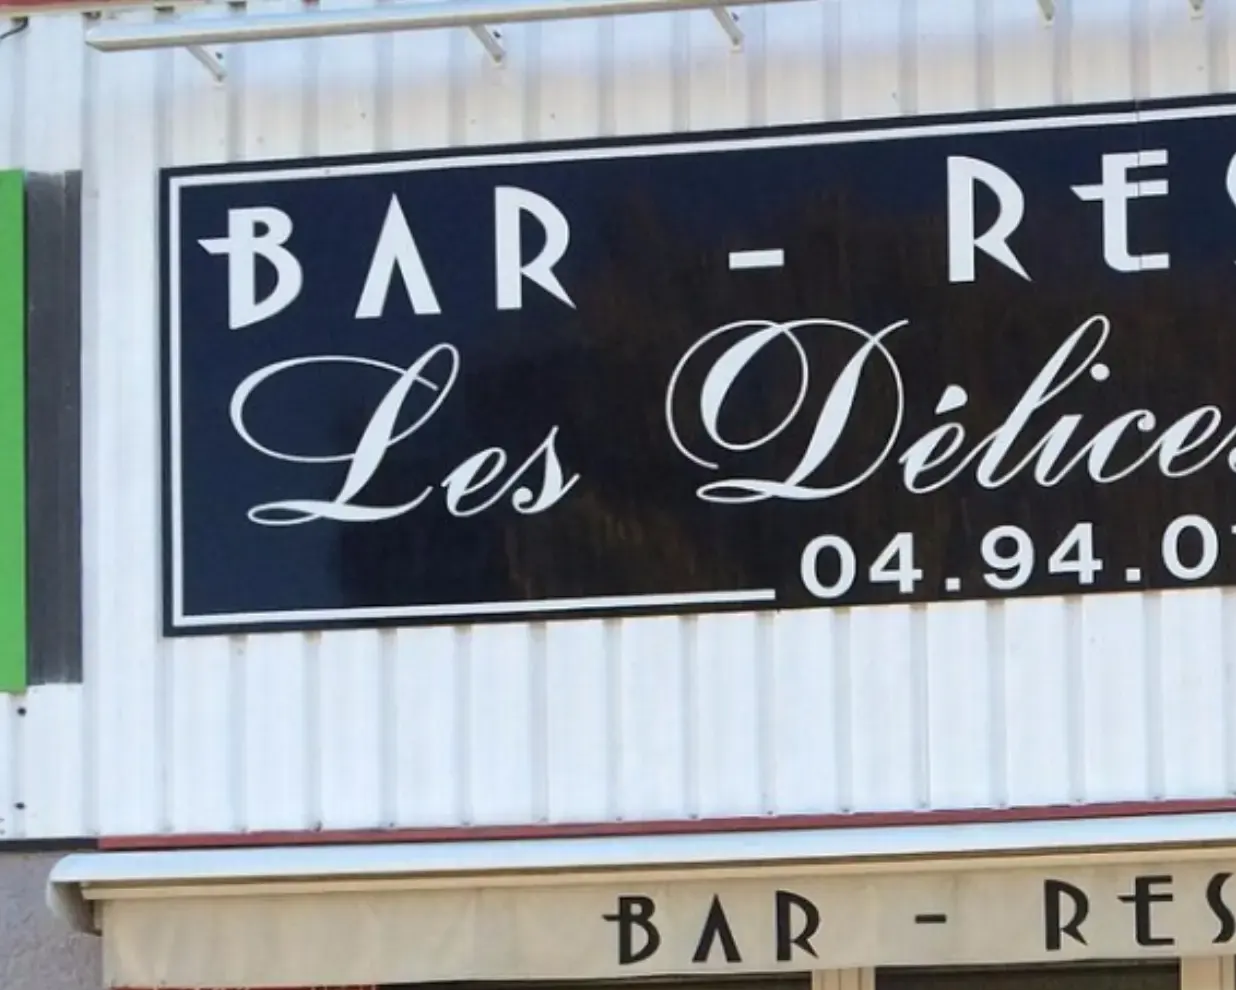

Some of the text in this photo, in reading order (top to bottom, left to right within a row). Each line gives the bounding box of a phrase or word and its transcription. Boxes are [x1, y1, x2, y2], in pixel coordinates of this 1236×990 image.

[197, 186, 577, 330] BAR
[728, 248, 785, 270] -
[229, 342, 580, 525] Les
[602, 890, 821, 965] BAR
